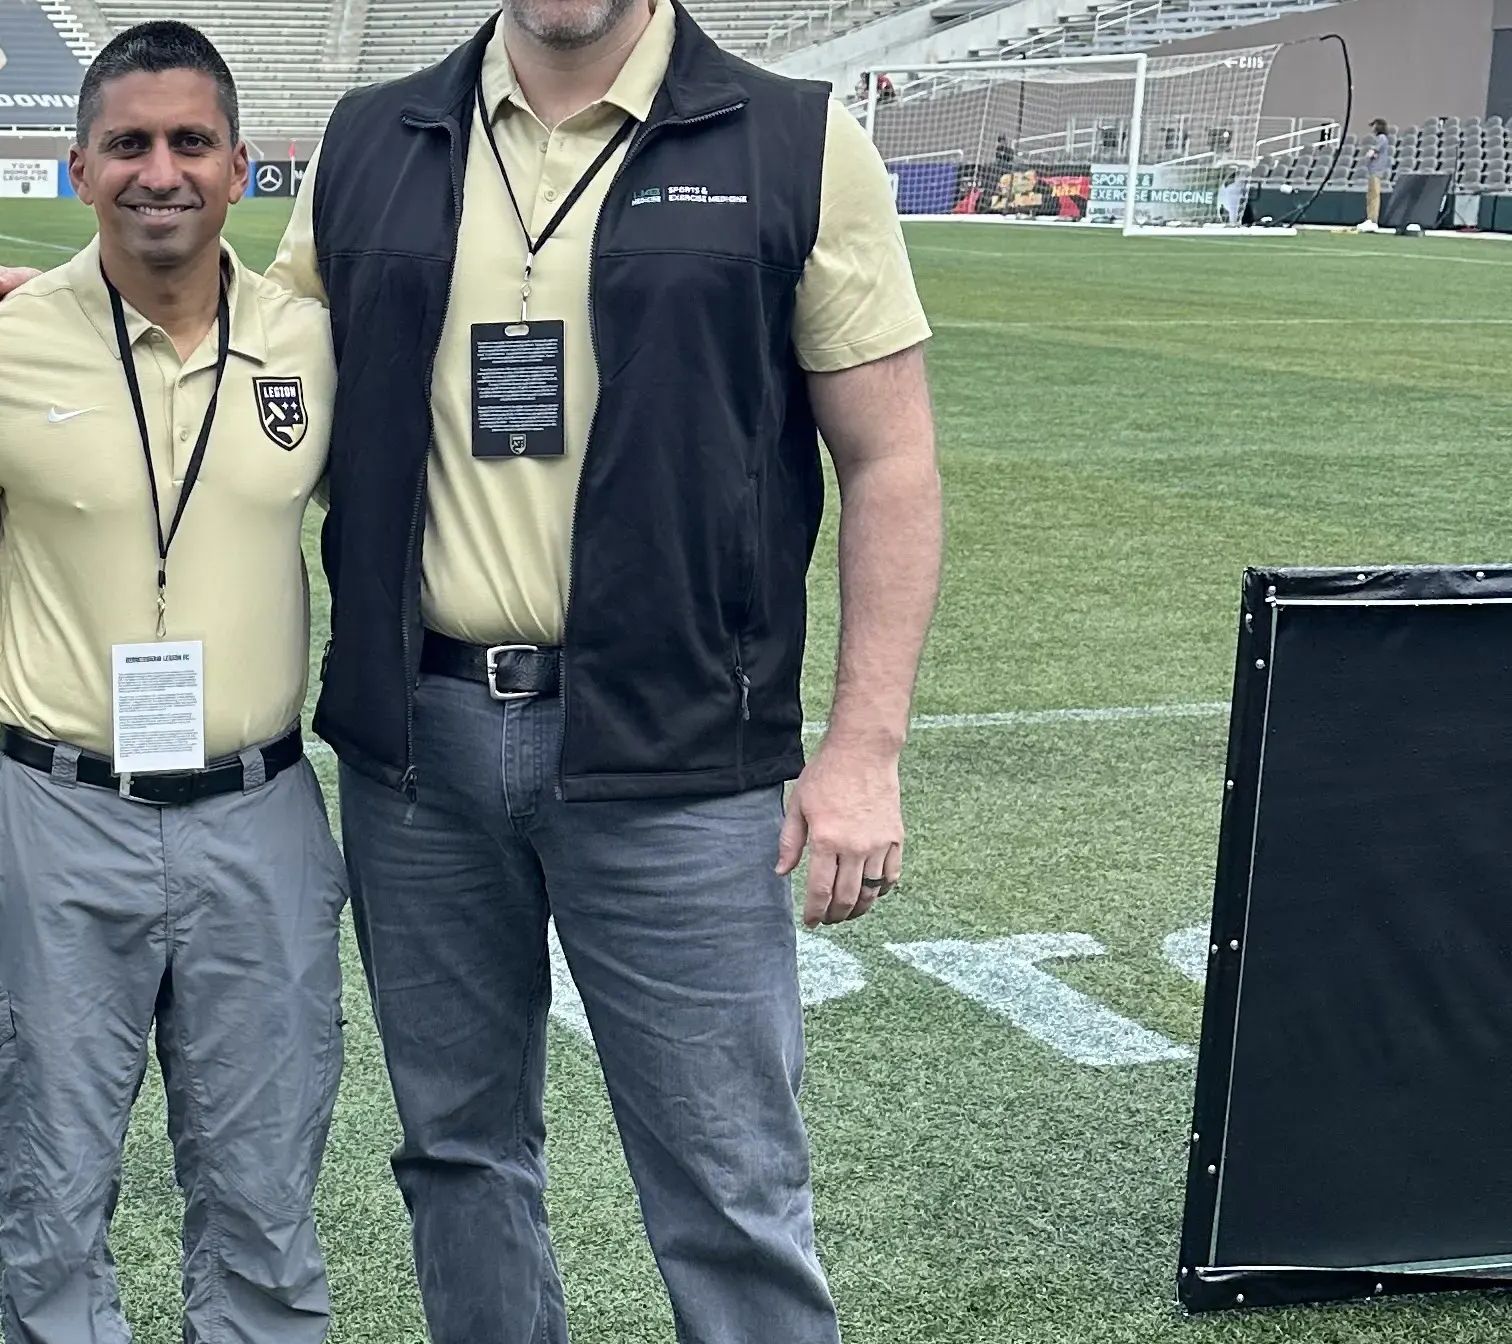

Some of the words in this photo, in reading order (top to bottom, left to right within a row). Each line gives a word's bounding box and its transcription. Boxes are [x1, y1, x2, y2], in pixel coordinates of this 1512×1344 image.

[668, 186, 700, 194] SPORTS
[1091, 188, 1148, 201] EXERCSE
[1151, 190, 1214, 205] MEDICINE
[263, 386, 297, 398] LEGION
